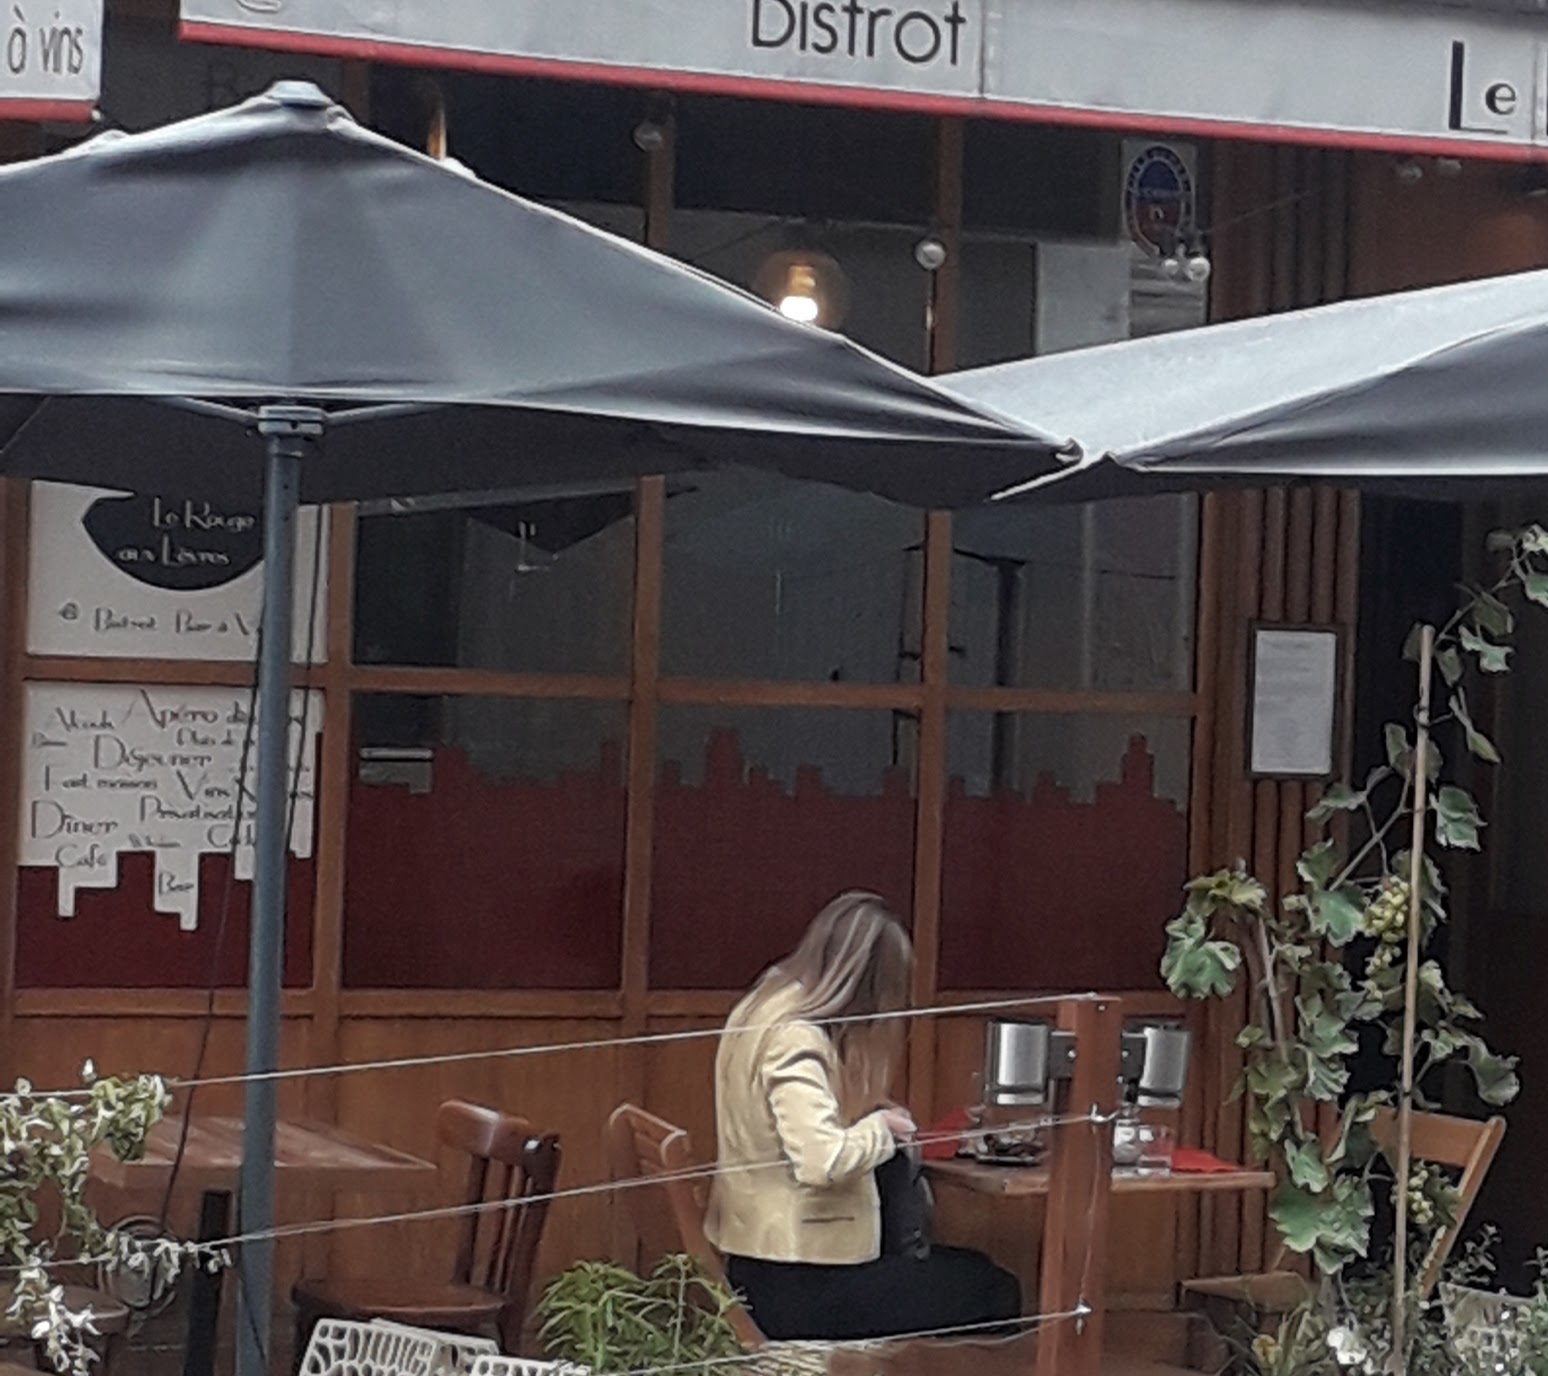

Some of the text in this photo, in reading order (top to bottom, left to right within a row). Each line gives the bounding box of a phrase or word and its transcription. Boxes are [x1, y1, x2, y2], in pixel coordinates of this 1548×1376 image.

[6, 4, 85, 75] à vins
[1447, 39, 1519, 136] Le
